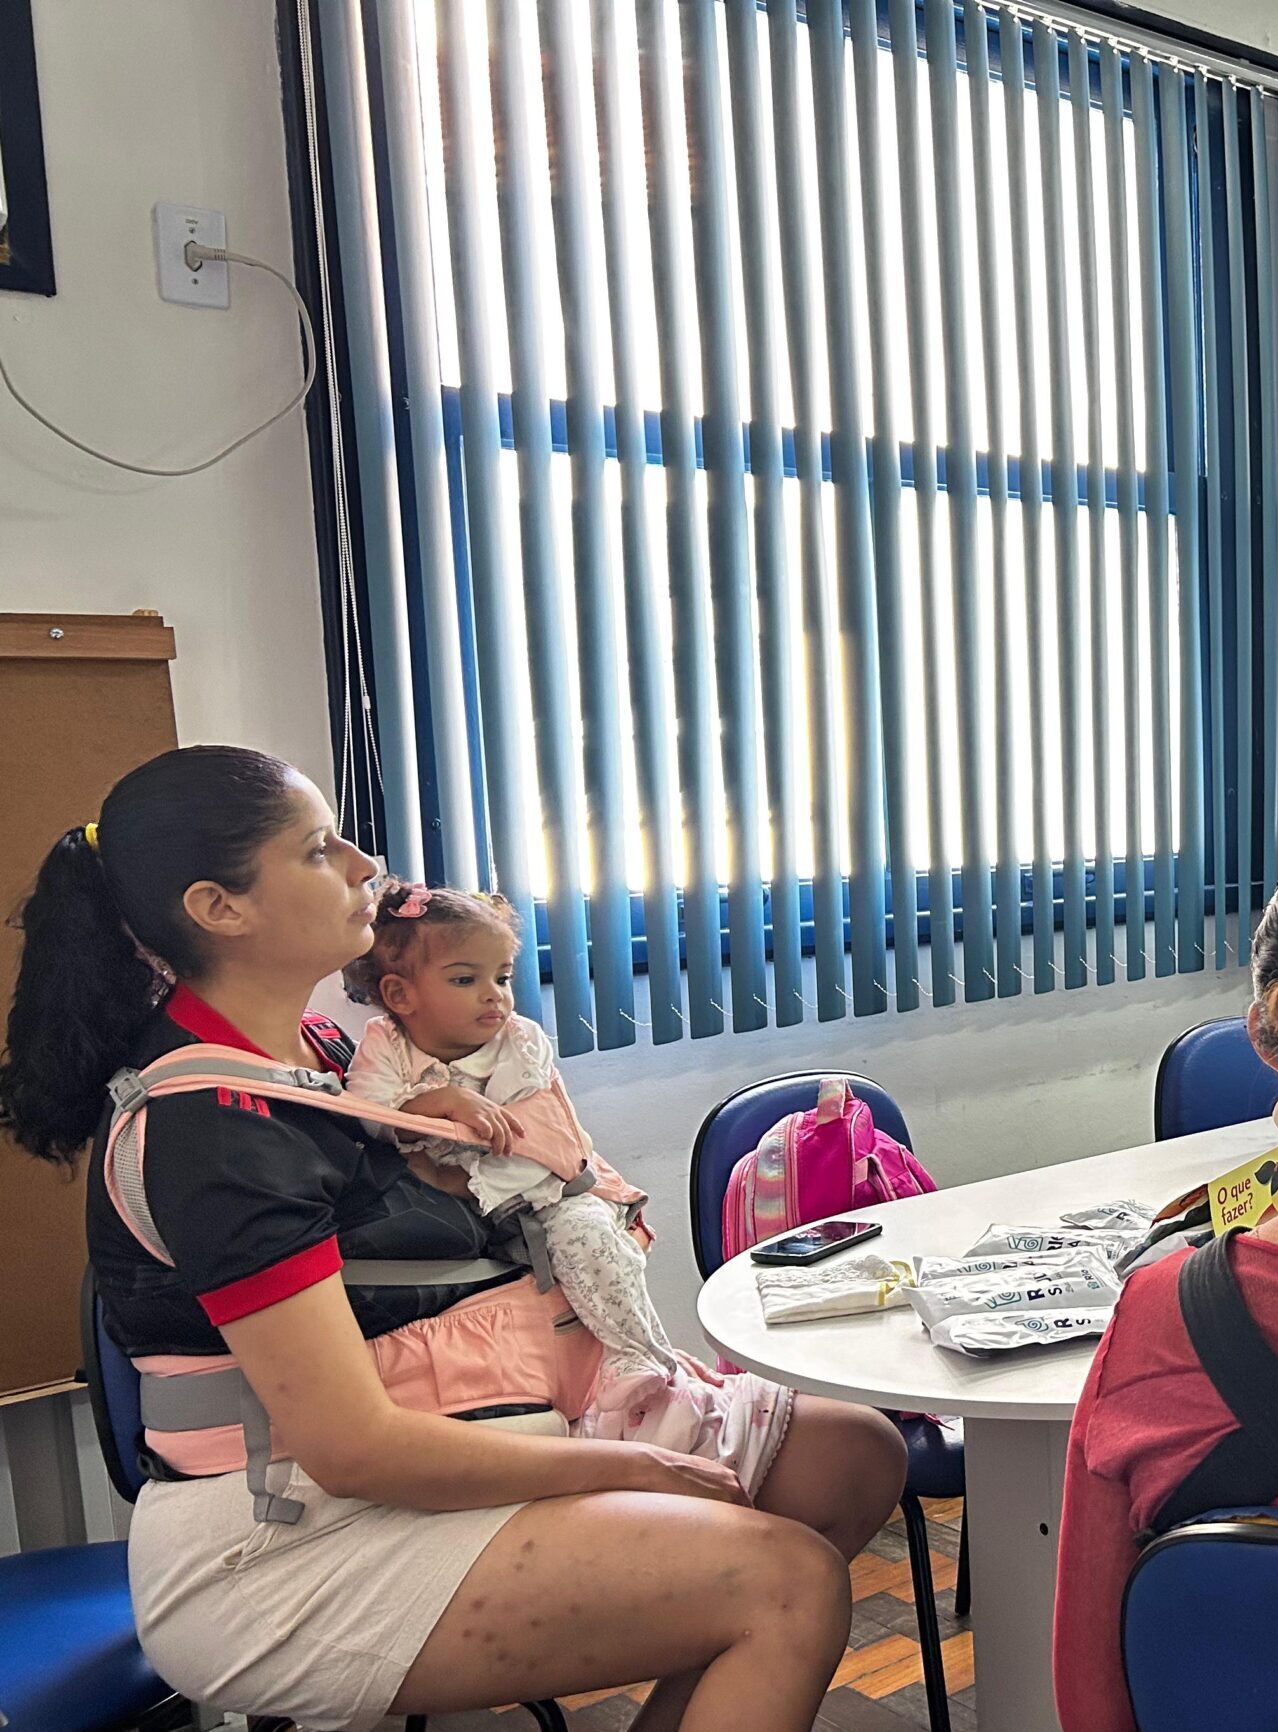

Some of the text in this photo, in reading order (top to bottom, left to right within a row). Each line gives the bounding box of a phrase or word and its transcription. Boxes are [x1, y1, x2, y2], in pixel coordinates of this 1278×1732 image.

[1217, 1178, 1251, 1205] O que
[1221, 1193, 1253, 1226] fazer?
